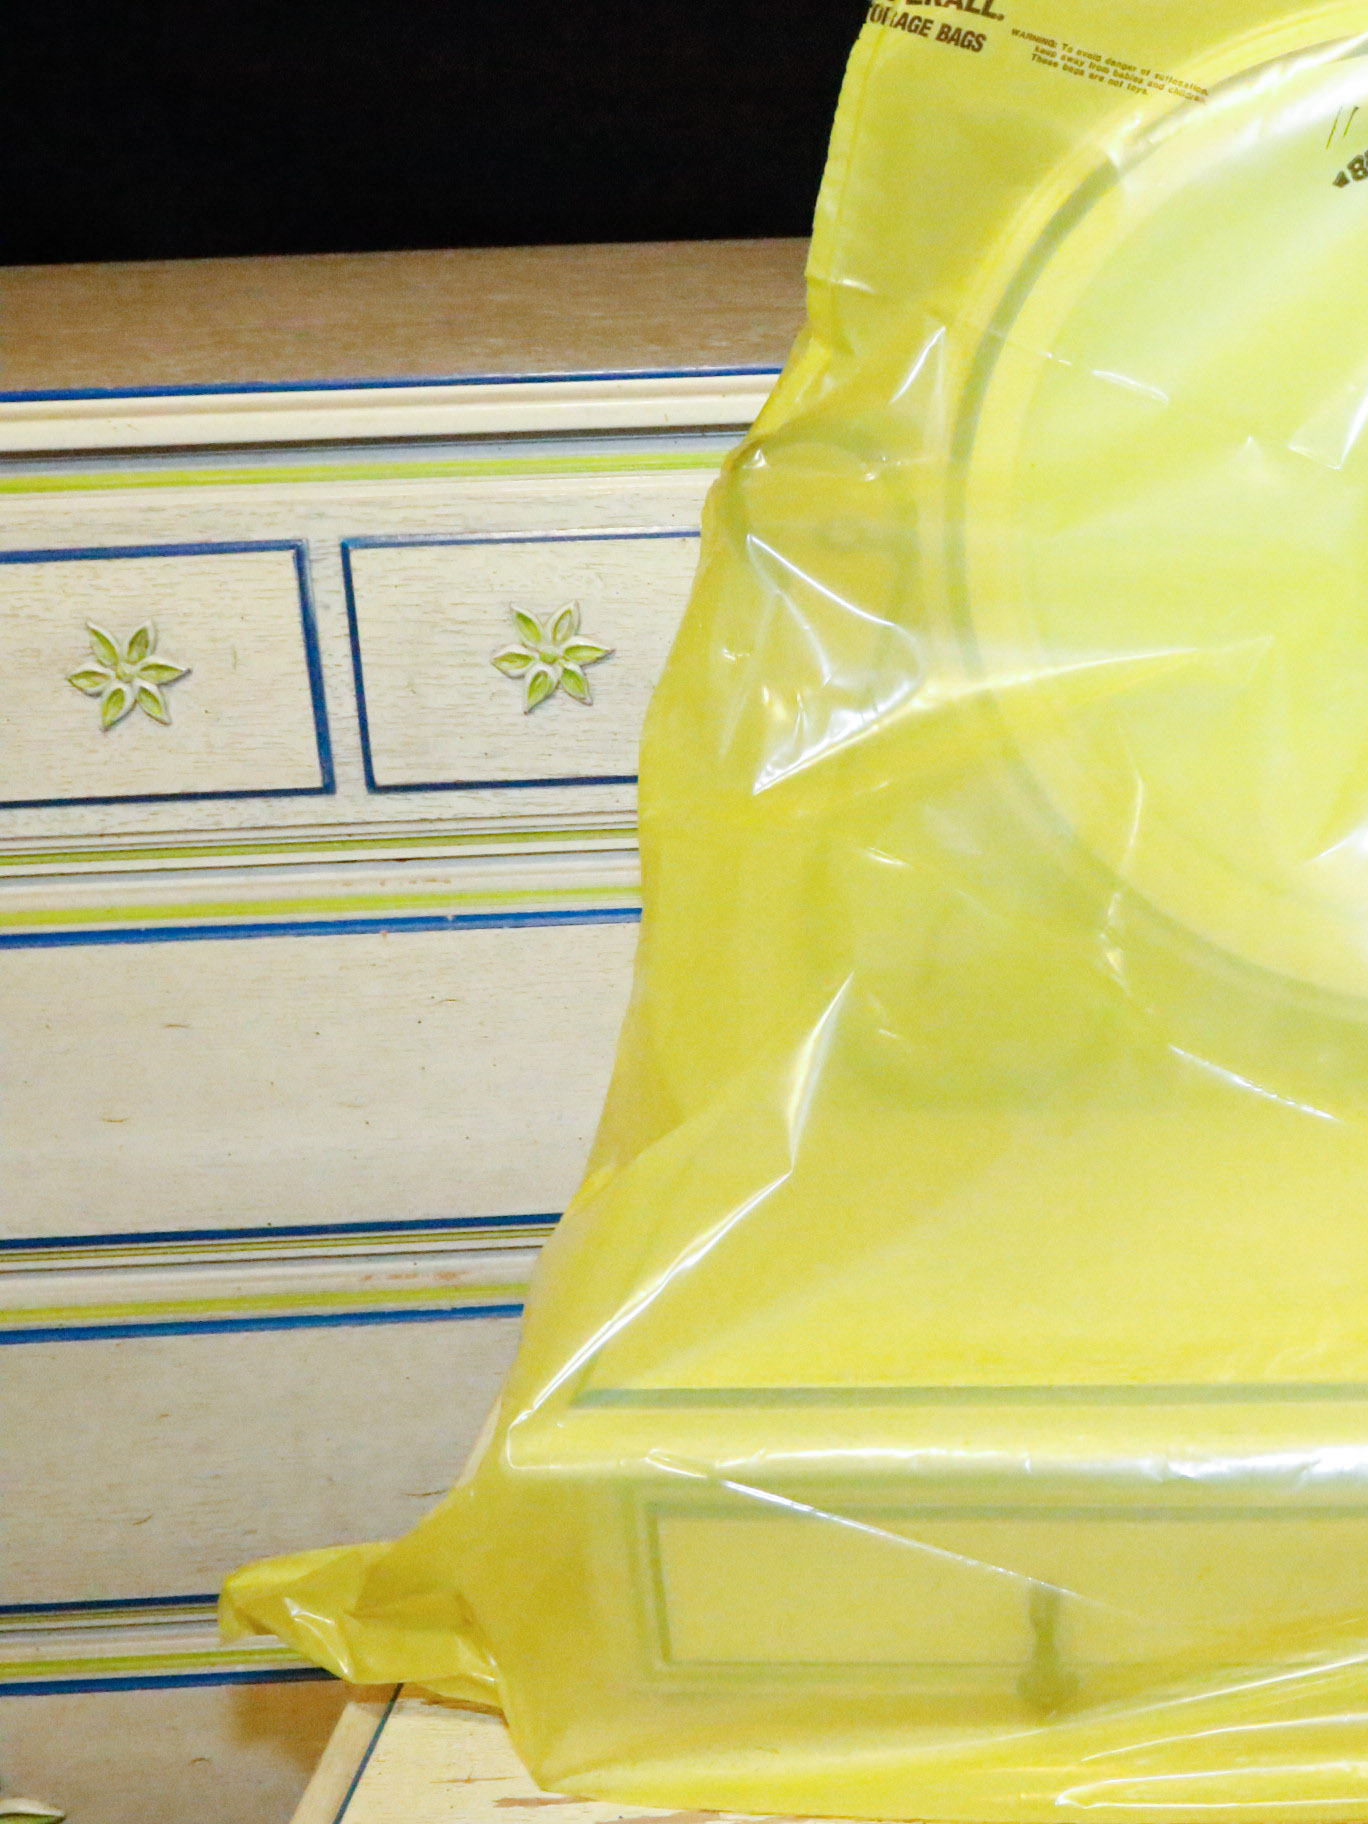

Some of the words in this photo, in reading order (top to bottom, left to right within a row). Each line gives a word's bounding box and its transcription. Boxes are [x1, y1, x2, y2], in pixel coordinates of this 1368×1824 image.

[935, 23, 987, 53] BAGS
[1031, 53, 1059, 67] These
[1062, 63, 1084, 76] bags
[1088, 73, 1104, 82] are
[1107, 79, 1123, 88] not
[1034, 46, 1057, 58] keep
[1060, 54, 1085, 67] away
[1088, 61, 1110, 74] from
[1113, 69, 1144, 84] babies
[1147, 81, 1165, 91] and
[1062, 43, 1073, 53] To
[1076, 49, 1102, 62] avoid
[1105, 57, 1137, 72] danger
[1141, 68, 1151, 77] of
